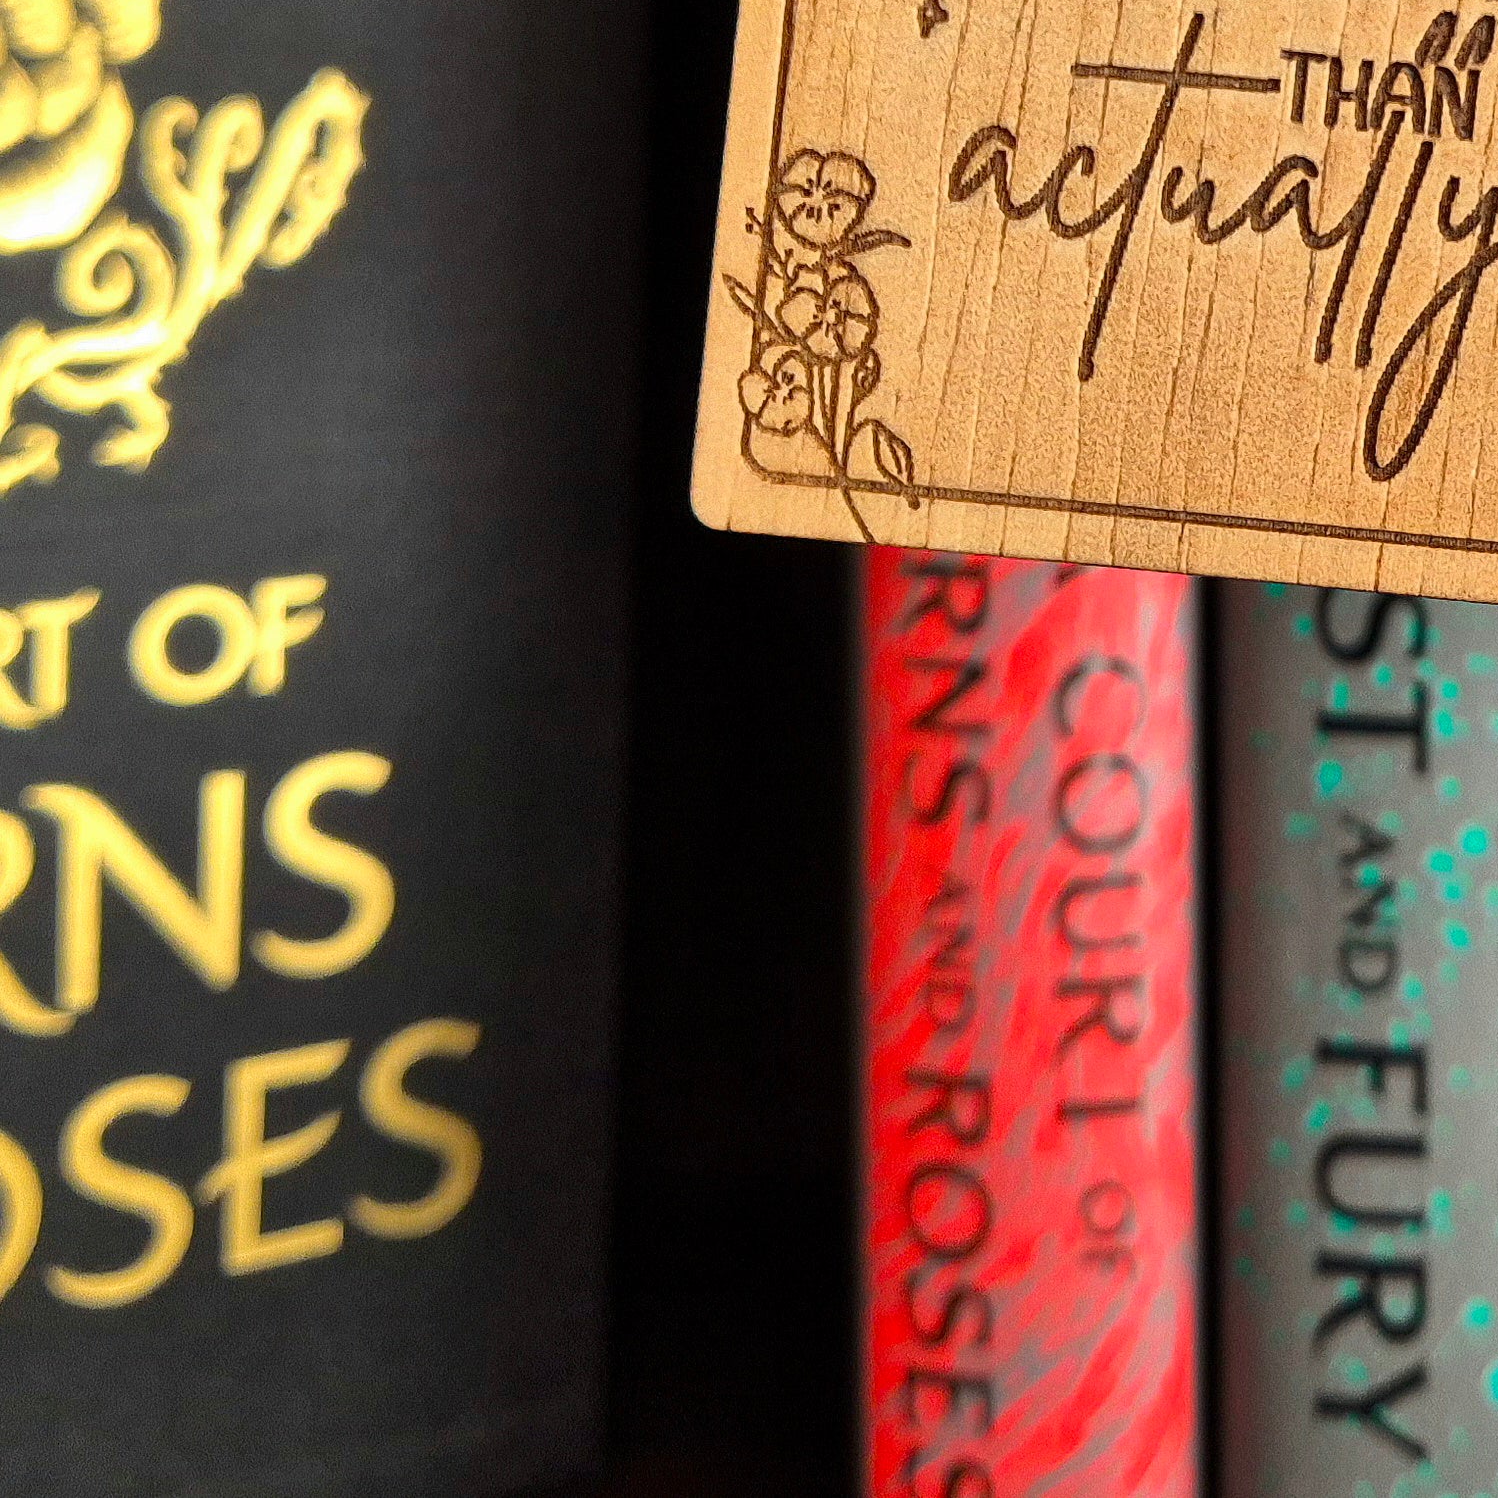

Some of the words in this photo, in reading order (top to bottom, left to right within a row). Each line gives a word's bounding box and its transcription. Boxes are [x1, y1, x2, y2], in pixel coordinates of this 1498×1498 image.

[1280, 48, 1480, 141] THAN
[127, 572, 328, 707] OF
[1052, 652, 1150, 1126] COURT
[1336, 810, 1399, 995] AND
[0, 1016, 484, 1309] SES
[1311, 1036, 1430, 1462] FURY
